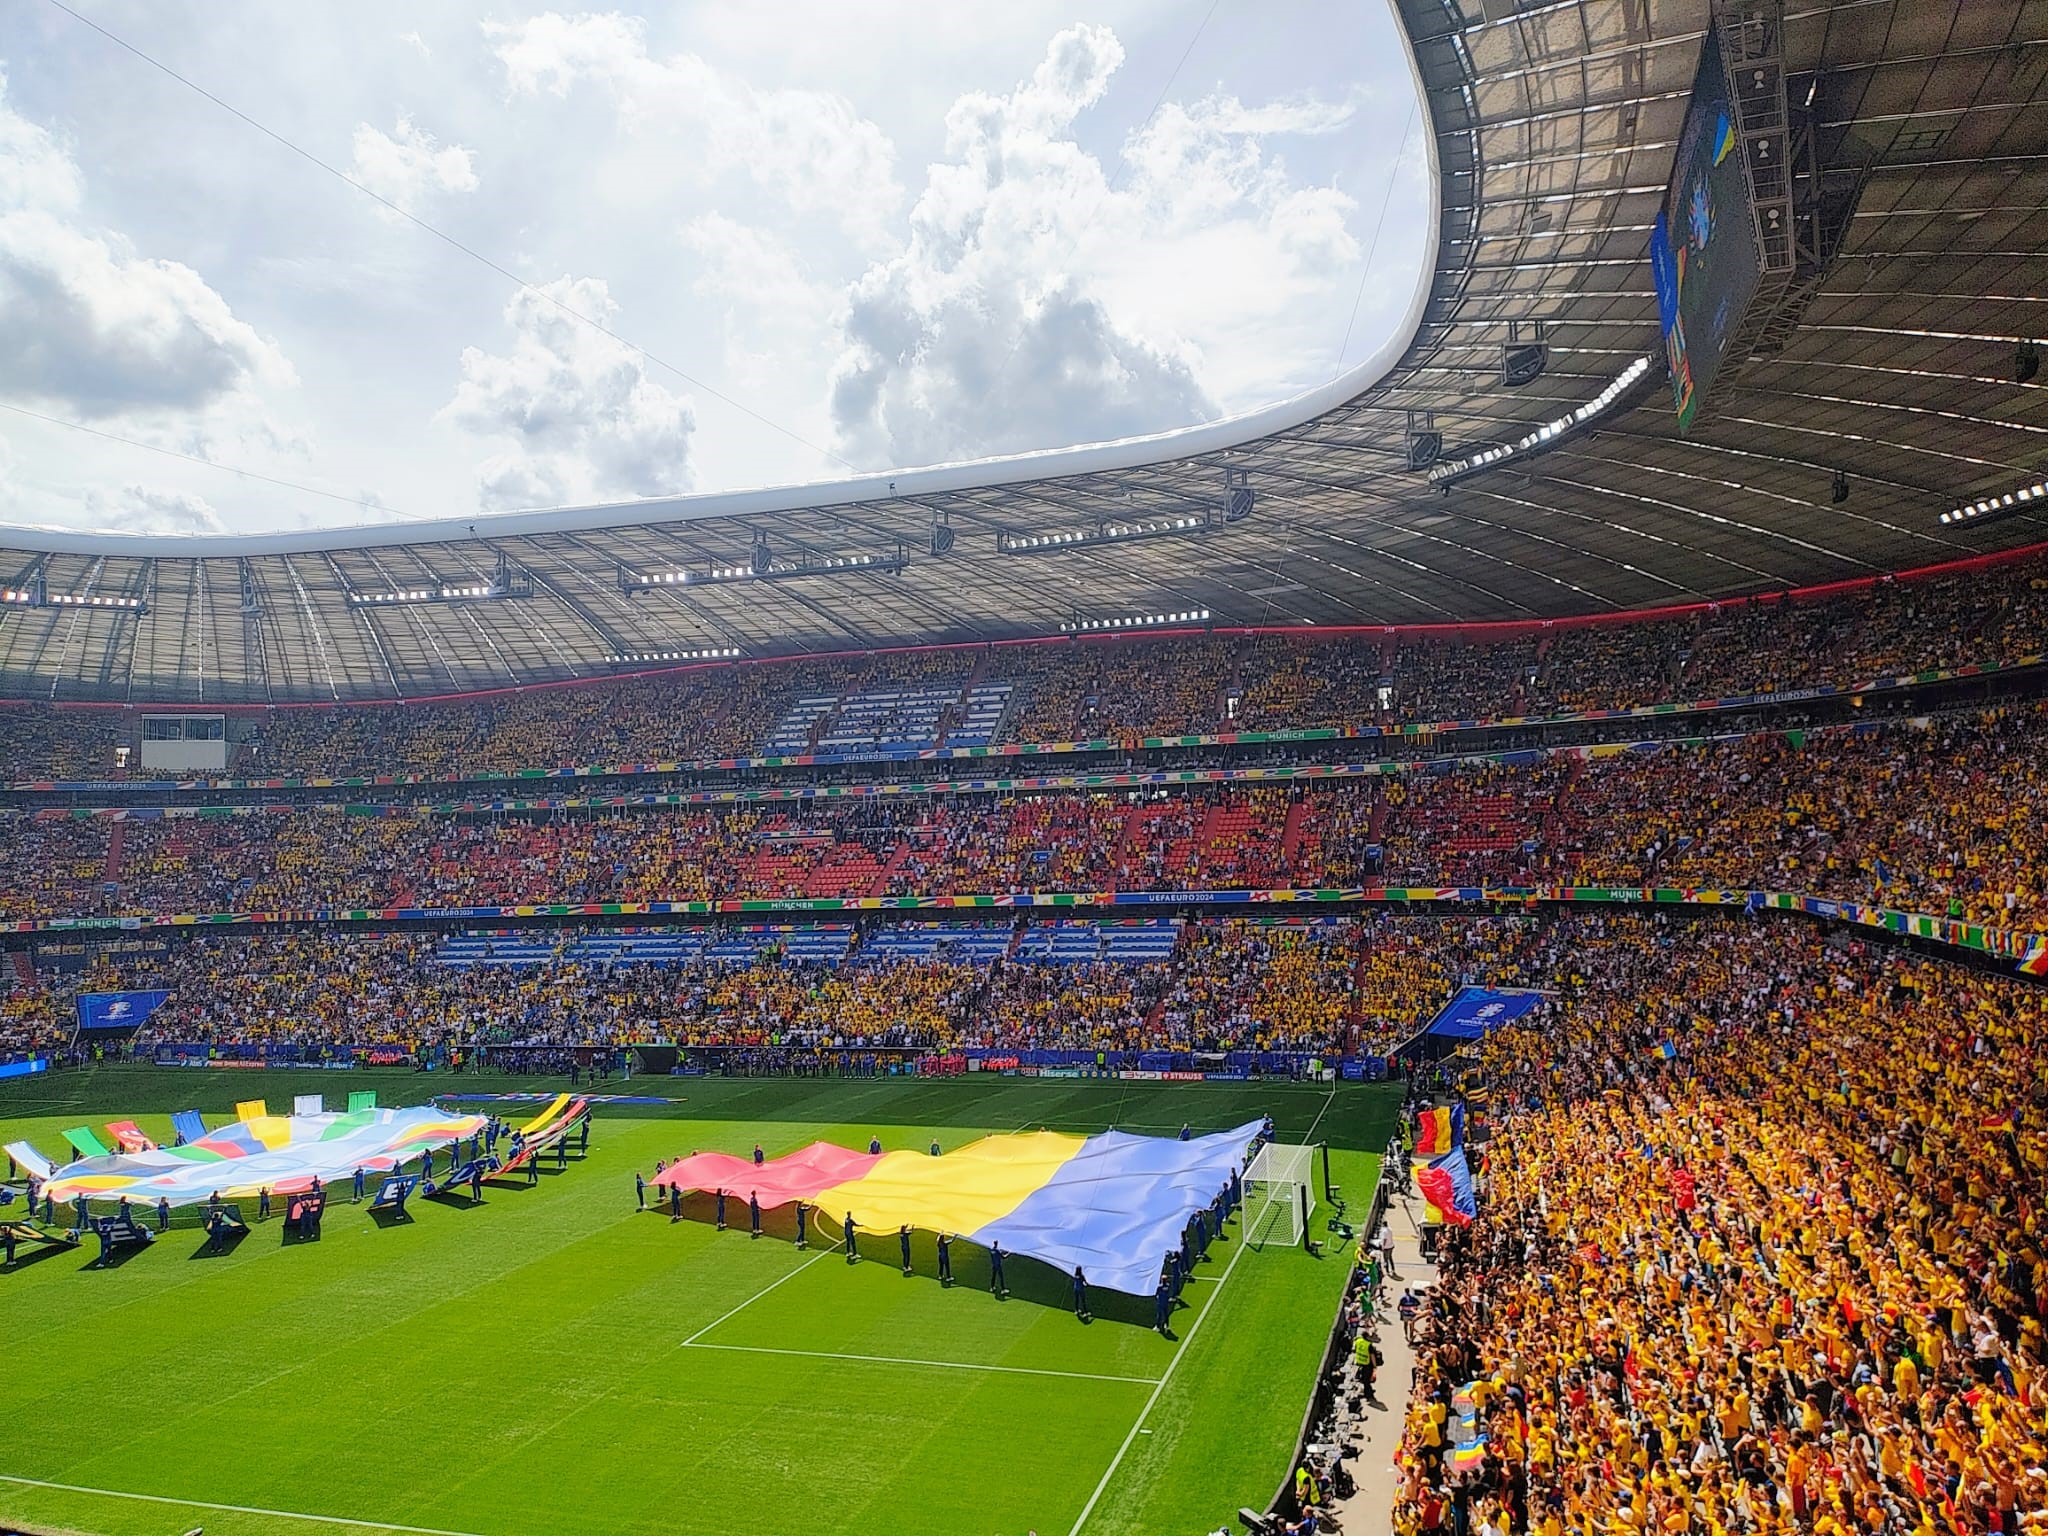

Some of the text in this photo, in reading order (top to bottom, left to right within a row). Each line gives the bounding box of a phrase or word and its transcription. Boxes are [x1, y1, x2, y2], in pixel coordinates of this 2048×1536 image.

[1268, 731, 1305, 740] MUNICH
[1610, 890, 1643, 899] MUNIC
[78, 919, 120, 928] MUNICH
[1124, 1071, 1156, 1079] BYD
[1169, 1071, 1203, 1080] STRAUSS
